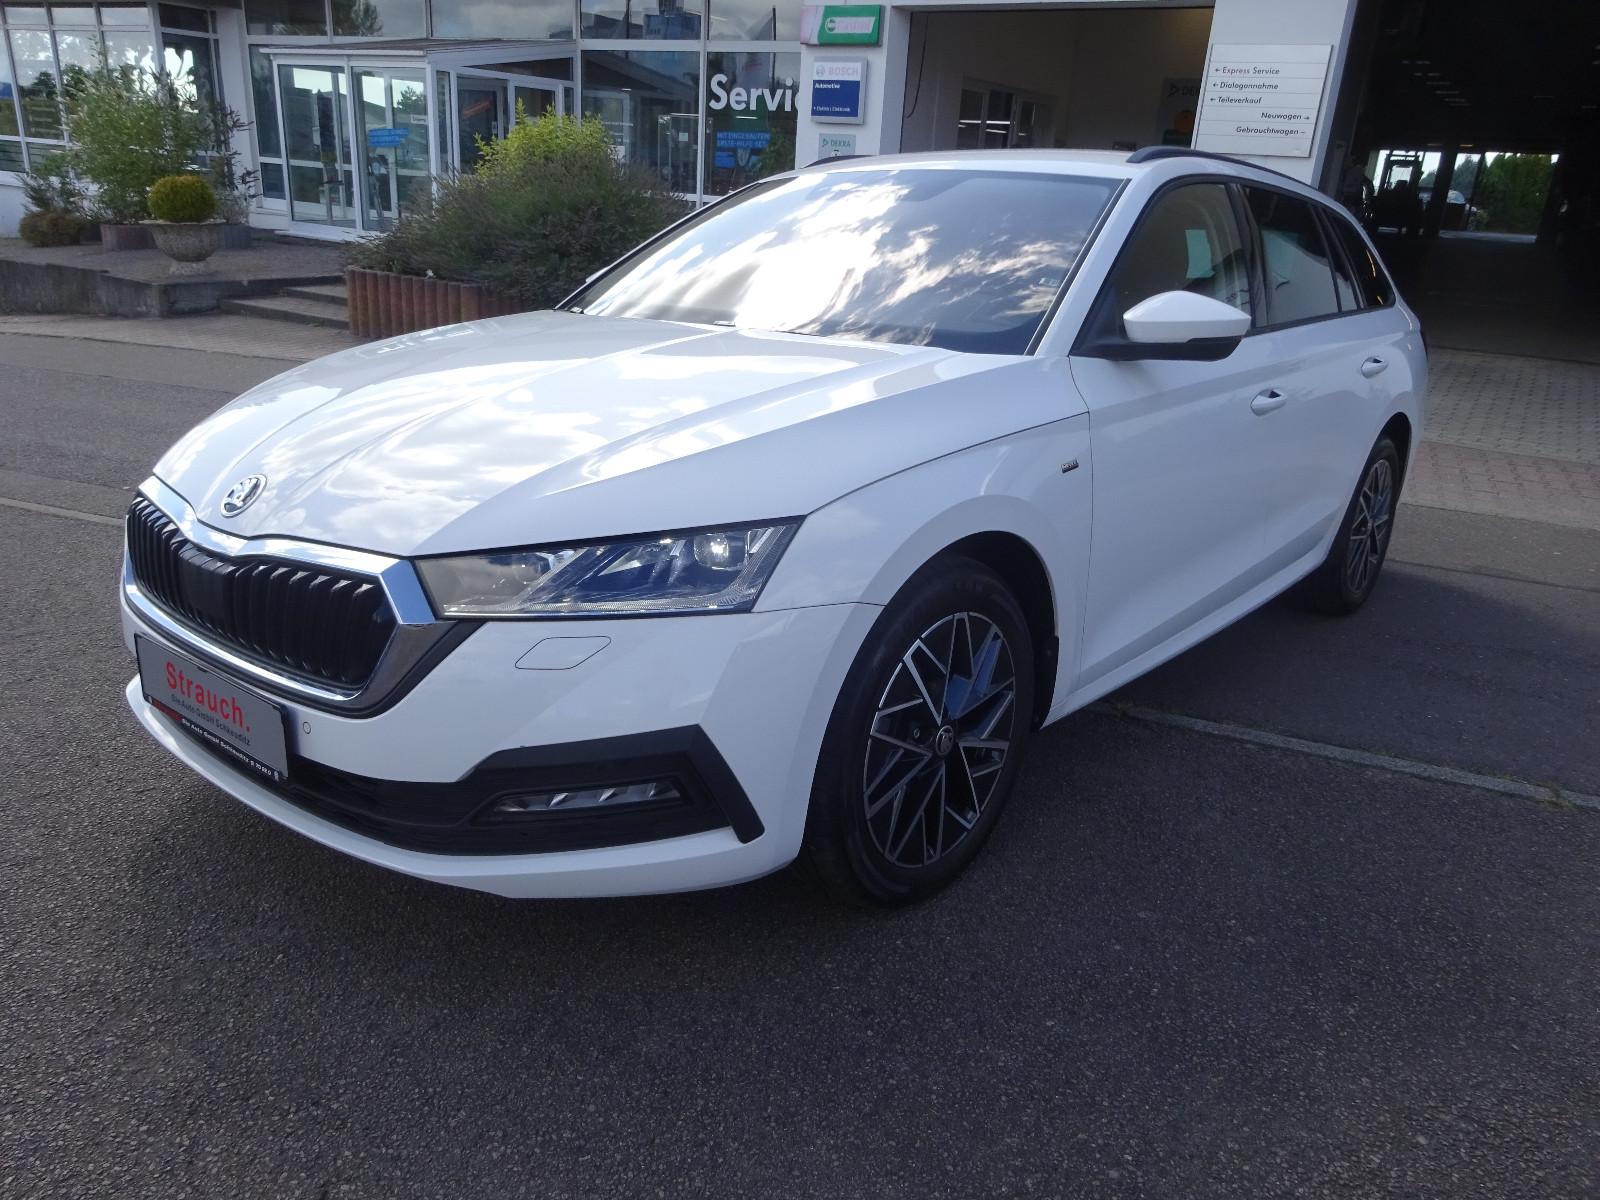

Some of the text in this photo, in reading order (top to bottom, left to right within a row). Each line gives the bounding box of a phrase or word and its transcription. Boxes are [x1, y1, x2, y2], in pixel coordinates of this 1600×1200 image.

[828, 66, 859, 76] BOSCH
[1222, 66, 1280, 76] Express Service
[1219, 81, 1279, 90] Dialogannahme
[709, 73, 800, 112] Servi
[1218, 96, 1262, 104] Teileverkauf
[1260, 112, 1302, 121] Neuwagen
[1236, 126, 1299, 135] Gebrauchtwagen
[830, 138, 851, 148] DEKRA
